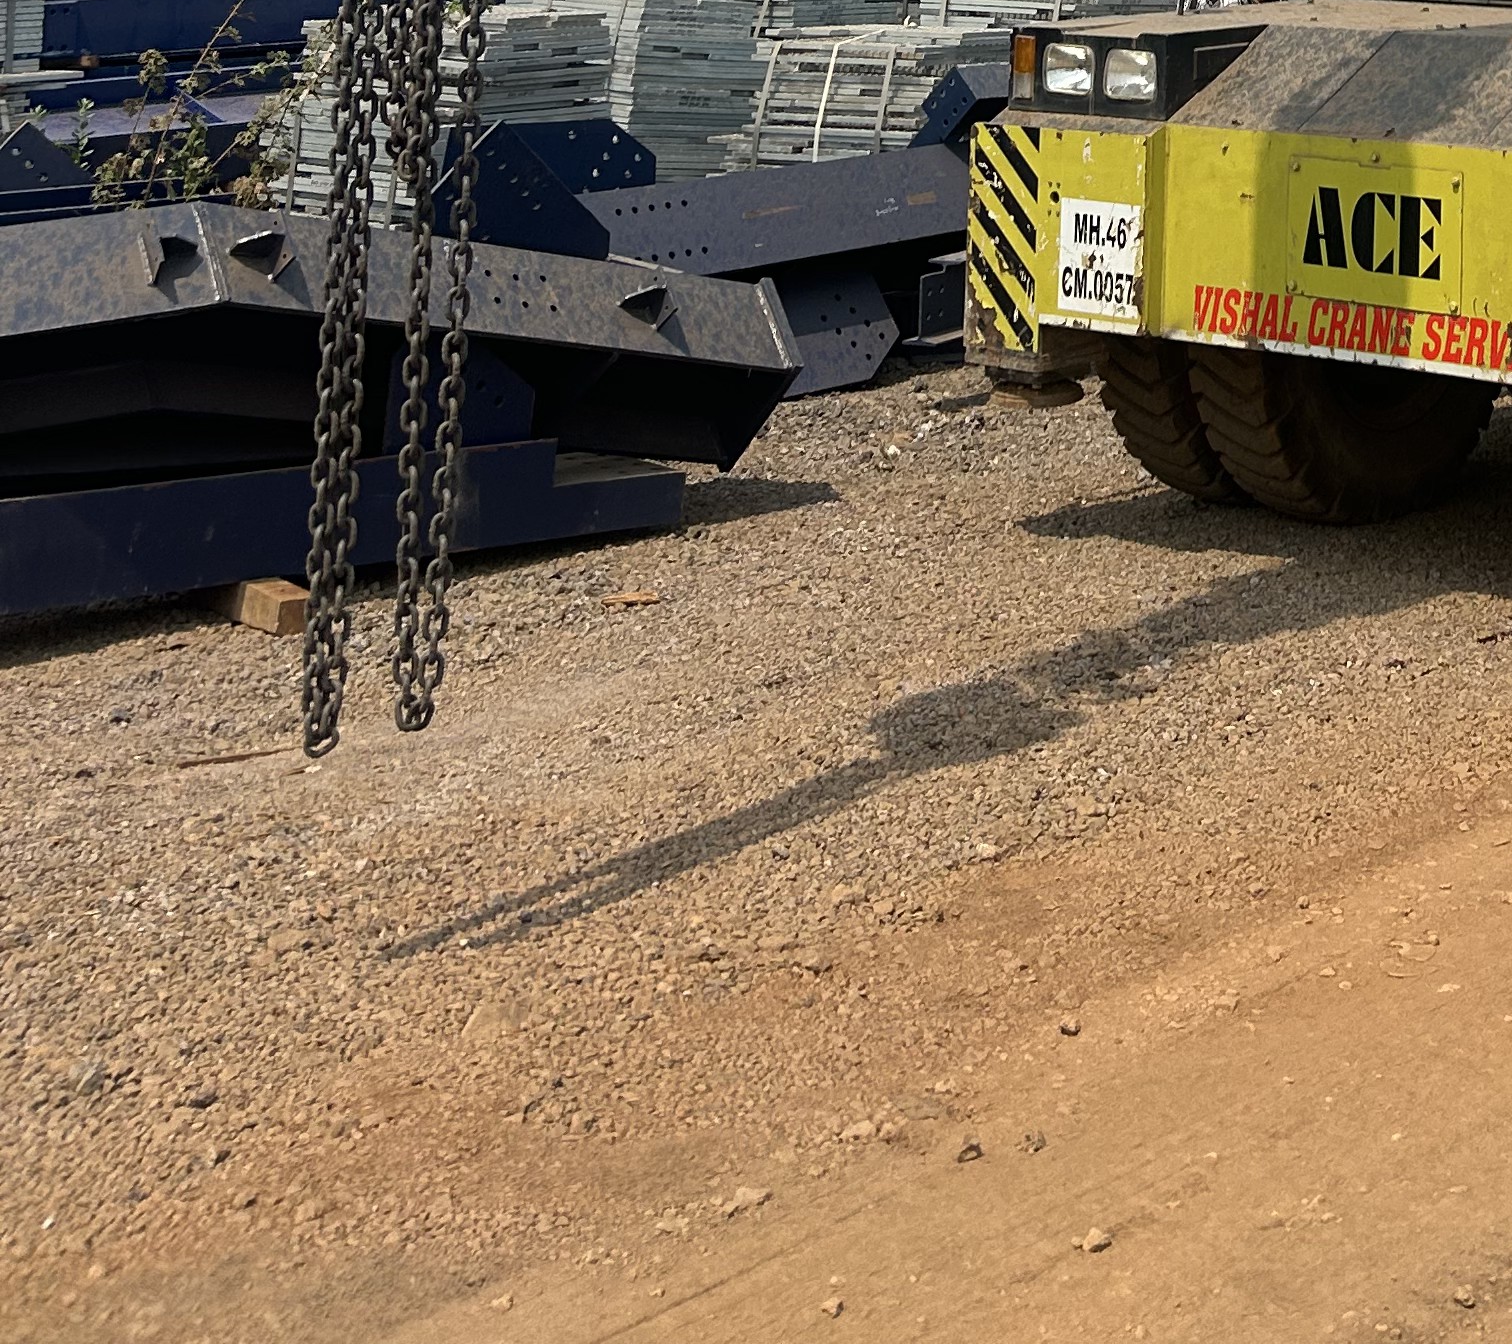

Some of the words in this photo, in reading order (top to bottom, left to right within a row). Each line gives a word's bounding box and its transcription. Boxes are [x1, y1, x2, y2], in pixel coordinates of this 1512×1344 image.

[1073, 213, 1128, 250] MH.46
[1302, 185, 1442, 281] ACE
[1061, 269, 1135, 306] CM.0057
[1193, 284, 1298, 342] VISHAL
[1308, 298, 1411, 357] CRANE
